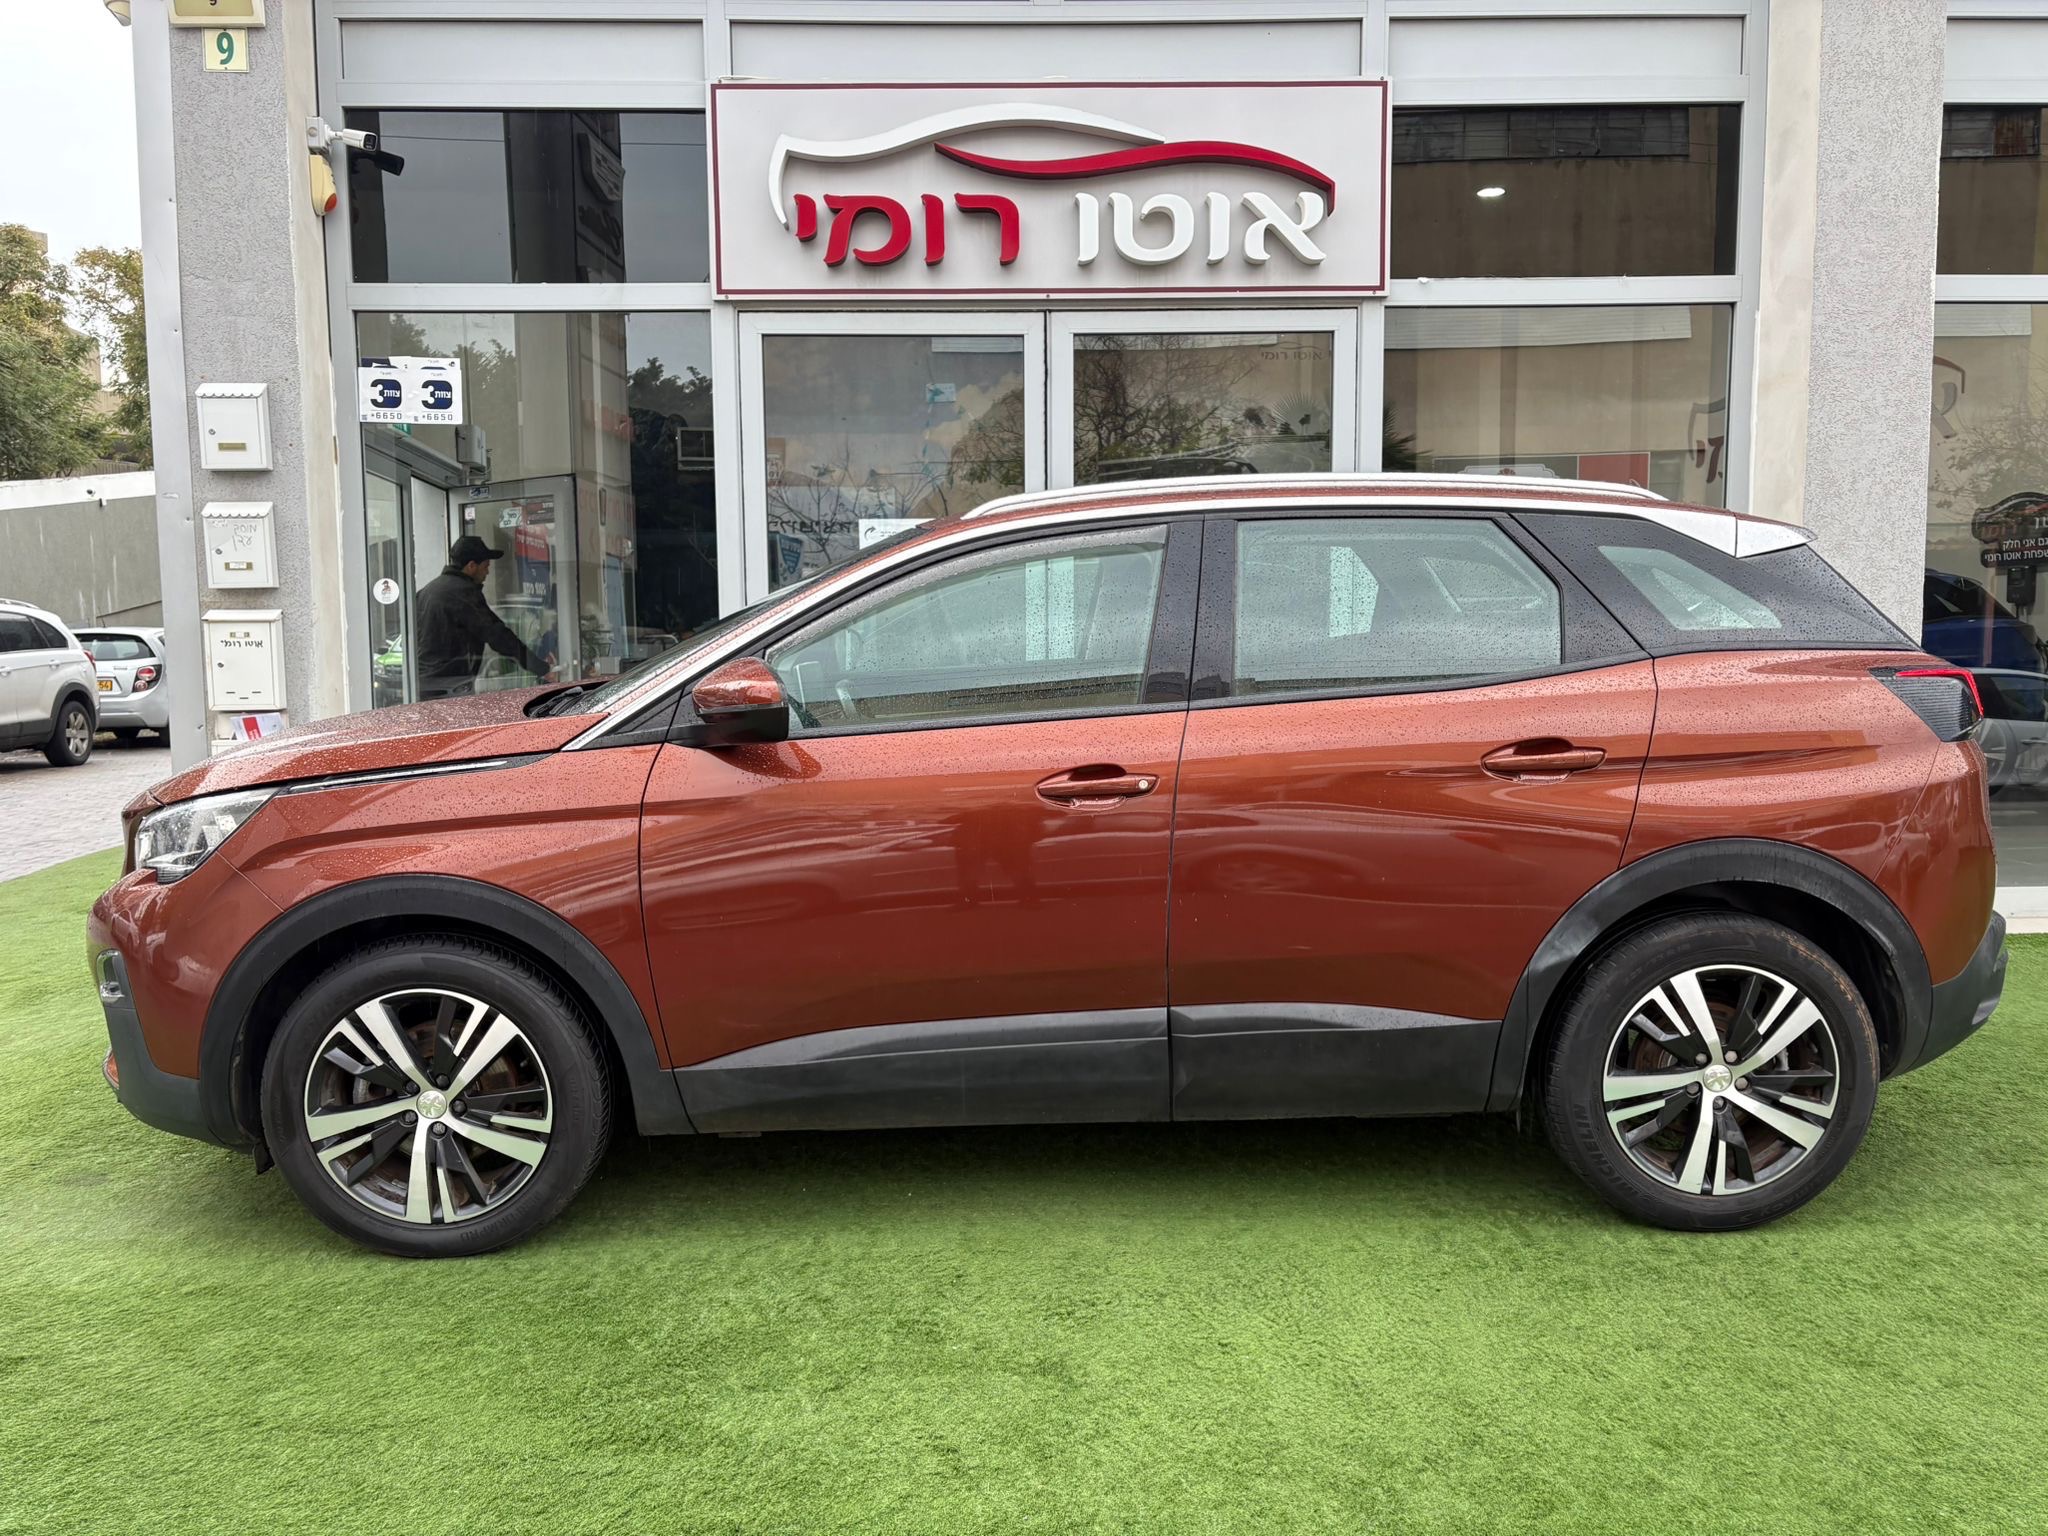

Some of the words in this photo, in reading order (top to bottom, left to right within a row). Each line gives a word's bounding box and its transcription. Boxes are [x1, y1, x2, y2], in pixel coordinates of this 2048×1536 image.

[216, 31, 235, 65] 9
[793, 192, 1021, 266] רומי
[1073, 191, 1327, 266] אוטו
[370, 384, 384, 403] 3
[383, 390, 401, 398] צוות
[421, 385, 435, 404] 3
[434, 390, 451, 399] צוות
[2002, 539, 2021, 550] חלק
[2022, 538, 2036, 548] אני
[2003, 551, 2021, 561] אוטו
[220, 640, 242, 648] רומי
[244, 640, 264, 648] אוטו
